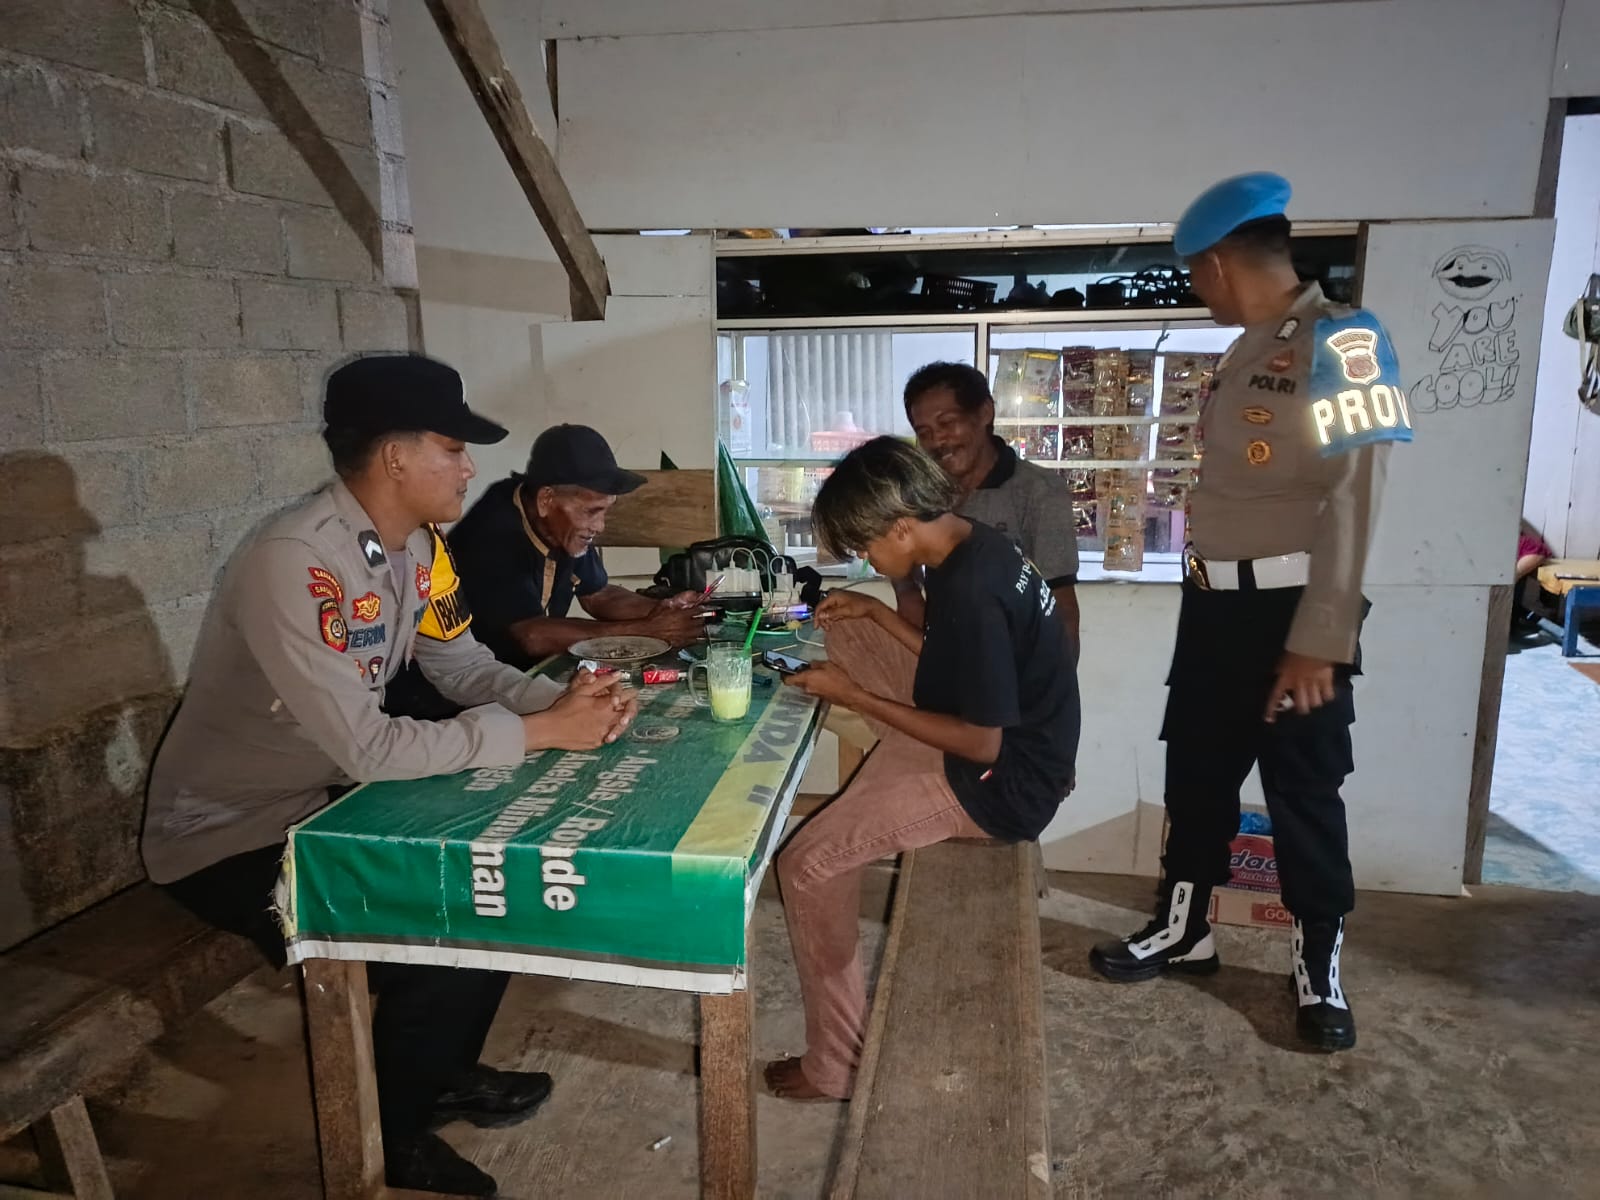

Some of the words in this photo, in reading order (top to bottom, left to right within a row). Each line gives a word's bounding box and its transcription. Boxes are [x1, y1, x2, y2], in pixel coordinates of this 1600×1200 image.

[1428, 297, 1515, 353] YOU
[1440, 330, 1519, 373] ARE
[1248, 374, 1296, 395] POLRI
[527, 751, 601, 794] Aneka
[587, 755, 660, 802] Angsle
[470, 796, 557, 918] Minuman
[539, 816, 609, 912] Ronde
